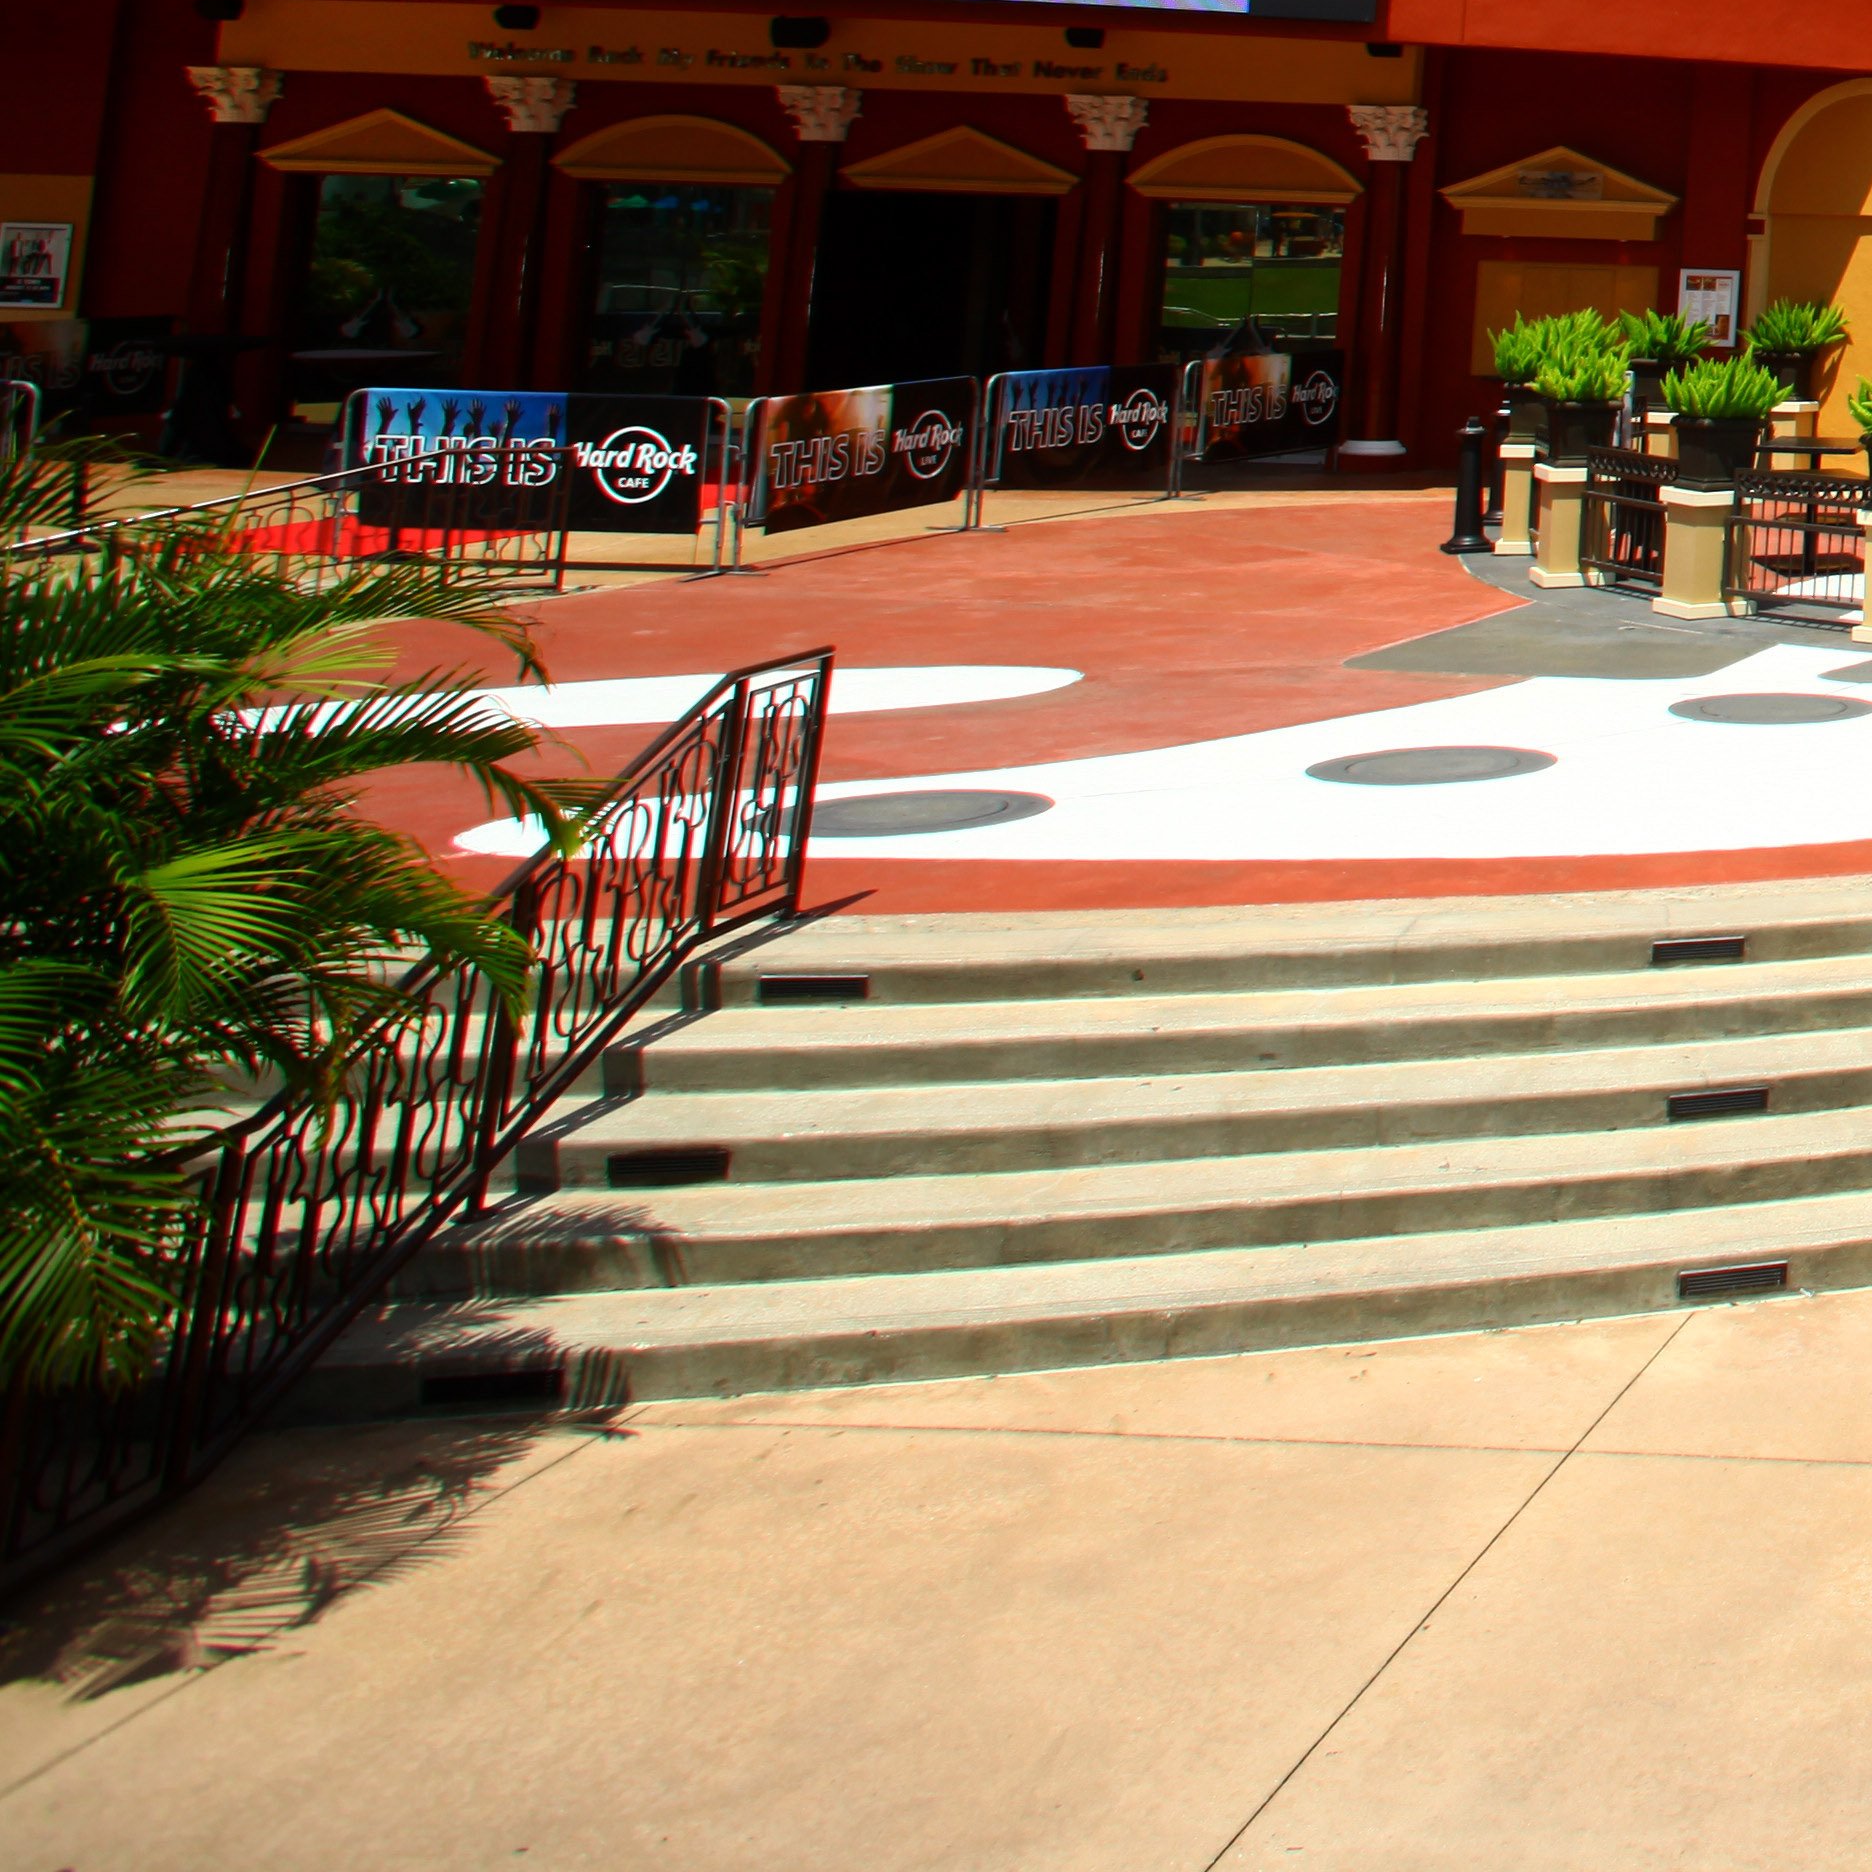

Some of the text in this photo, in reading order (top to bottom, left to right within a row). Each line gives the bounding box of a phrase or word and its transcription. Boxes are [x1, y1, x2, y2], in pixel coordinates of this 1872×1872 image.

[1032, 60, 1104, 80] Never
[1115, 62, 1169, 82] Ends
[1109, 400, 1168, 425] Hard Rock
[1211, 384, 1288, 427] THIS IS
[893, 421, 964, 454] Hard Rock
[1008, 403, 1103, 451] THIS IS
[373, 434, 558, 487] THIS IS
[573, 441, 698, 475] Hard Rock
[771, 430, 886, 489] THIS IS
[617, 476, 650, 490] CAFE
